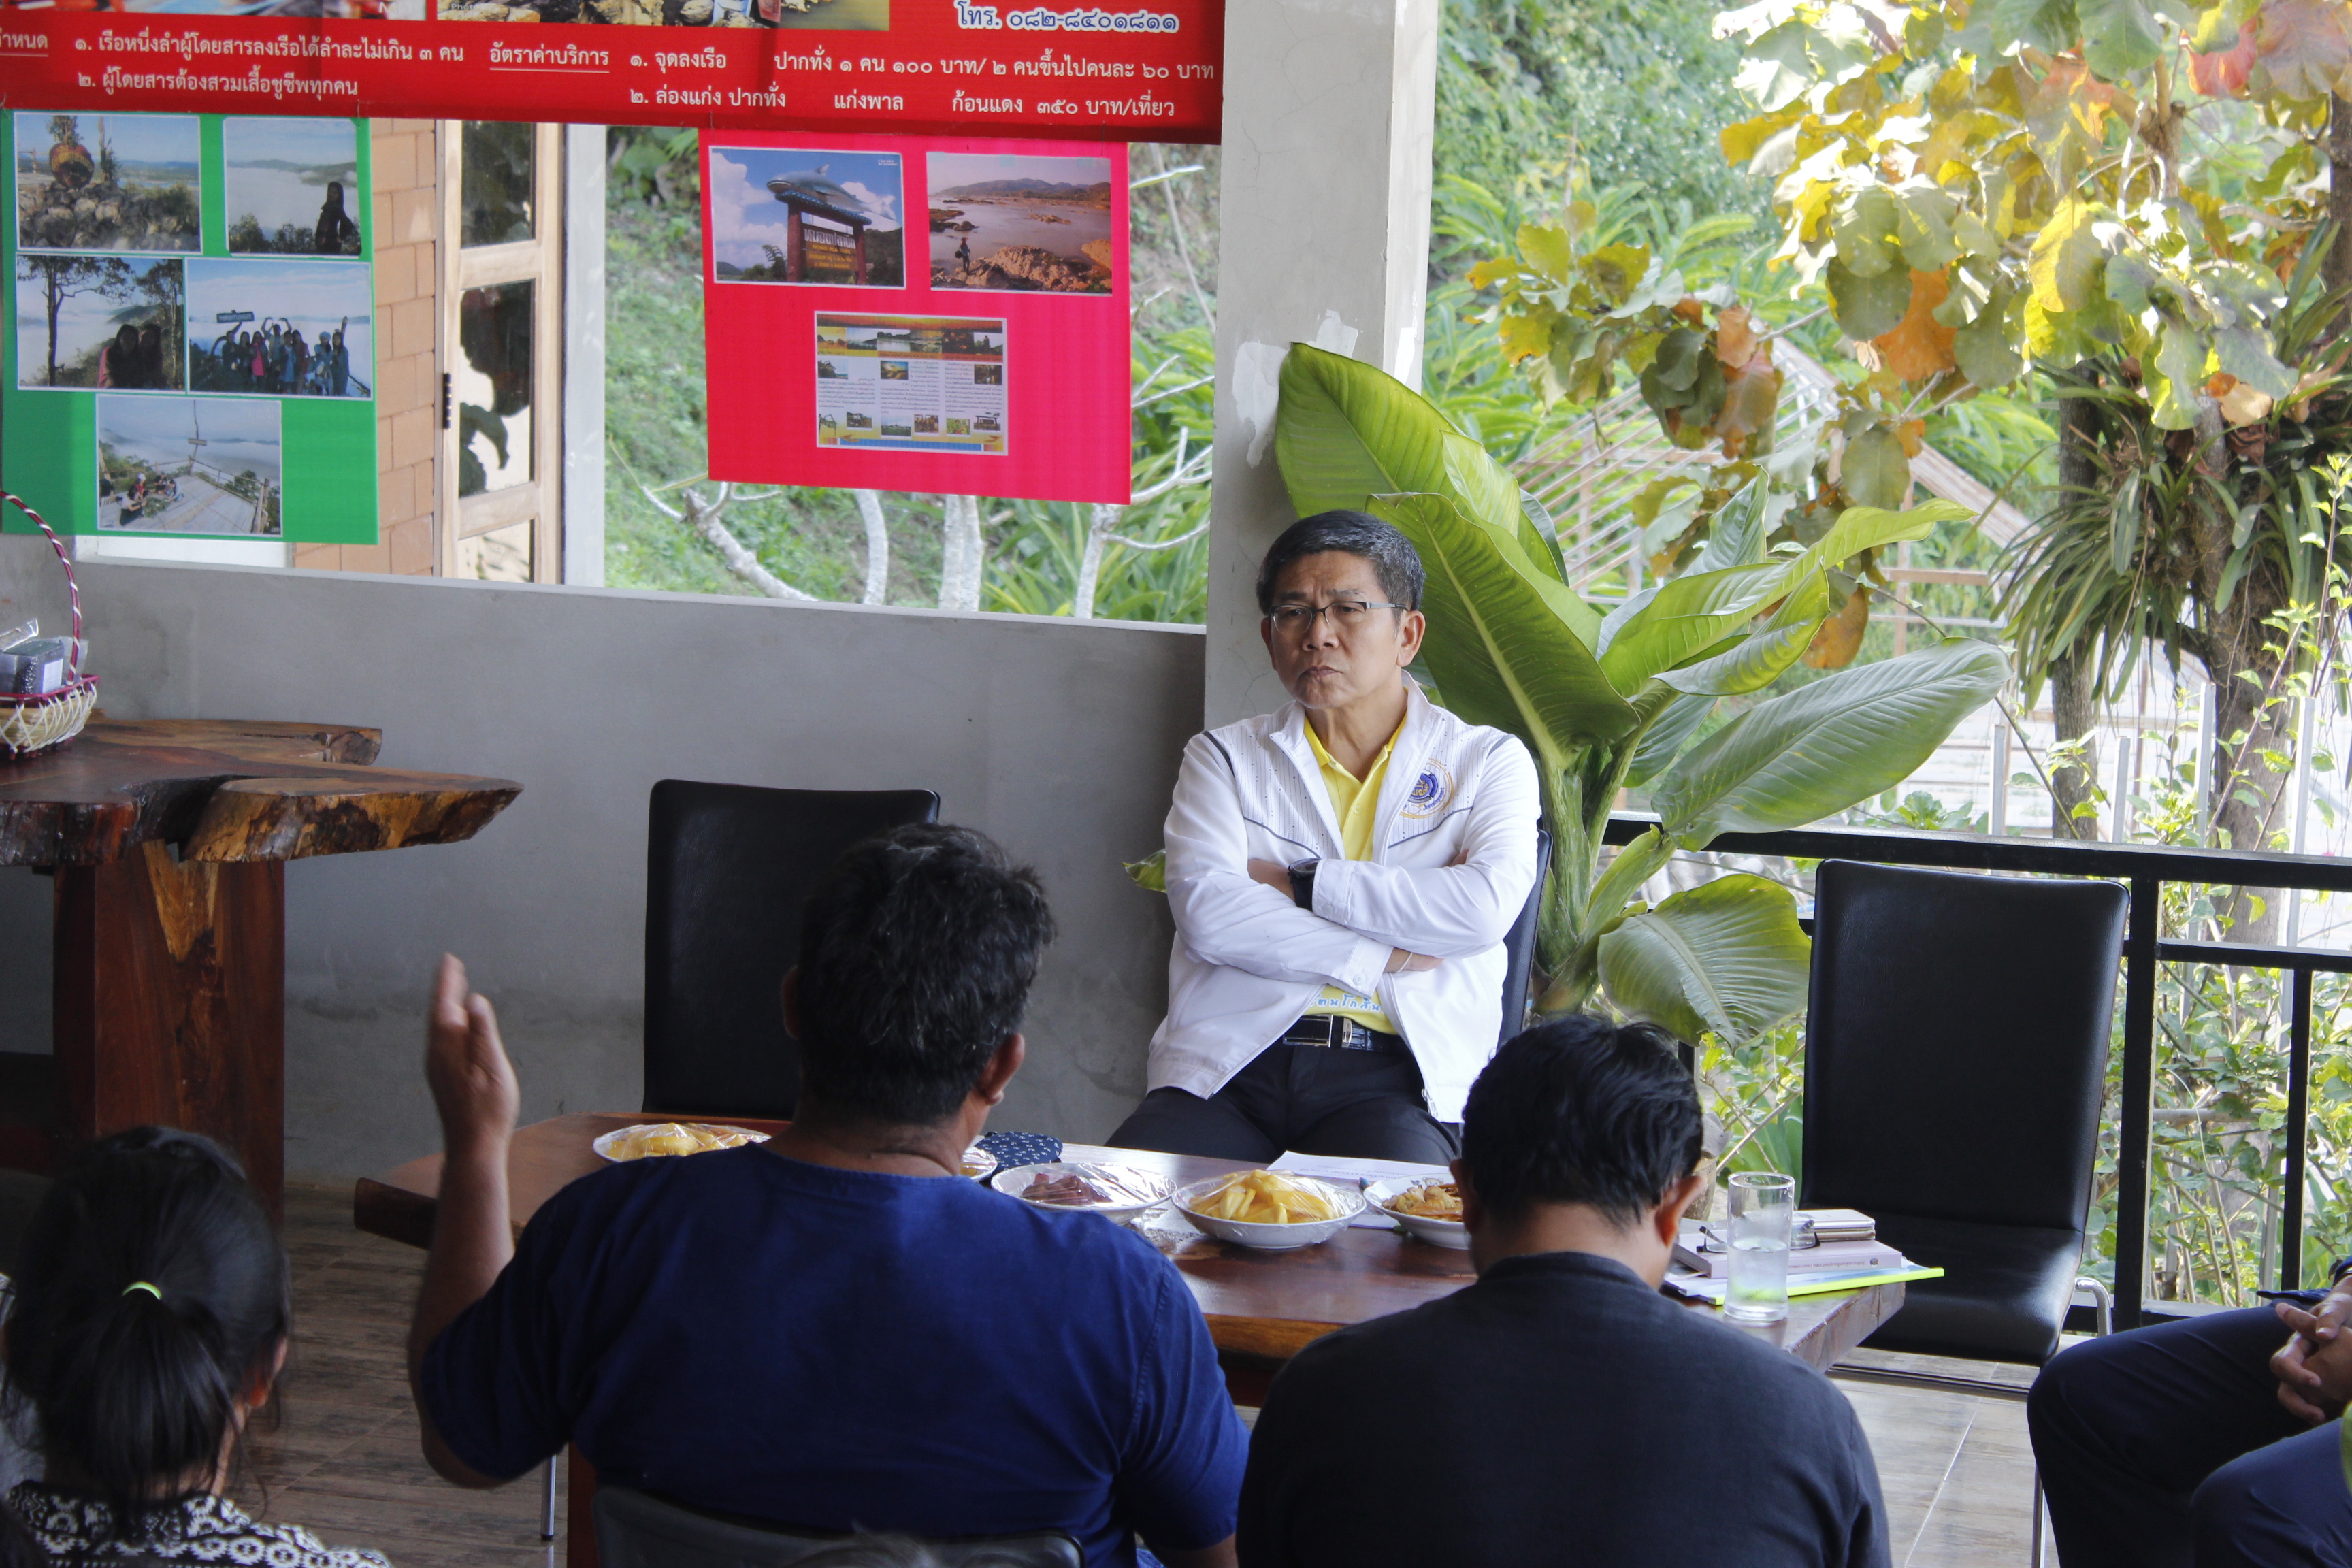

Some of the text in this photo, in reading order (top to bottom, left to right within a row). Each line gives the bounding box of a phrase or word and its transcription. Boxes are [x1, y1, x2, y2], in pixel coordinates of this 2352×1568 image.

[954, 0, 1000, 26] โทร.
[0, 27, 48, 49] ำหนด
[439, 46, 464, 62] คน
[489, 41, 609, 66] อัตราค่าบริการ
[655, 47, 727, 74] จุดลงเรือ
[860, 56, 885, 73] คน
[892, 61, 933, 74] ๑๐๐
[1013, 48, 1134, 78] คนขึ้นไปคนละ
[1141, 63, 1169, 79] ๖๐
[1177, 63, 1214, 79] บาท
[103, 65, 358, 101] ผู้โดยสารต้องสวมเสื้อชูชีพทุกคน
[655, 86, 721, 105] ล่องแก่ง
